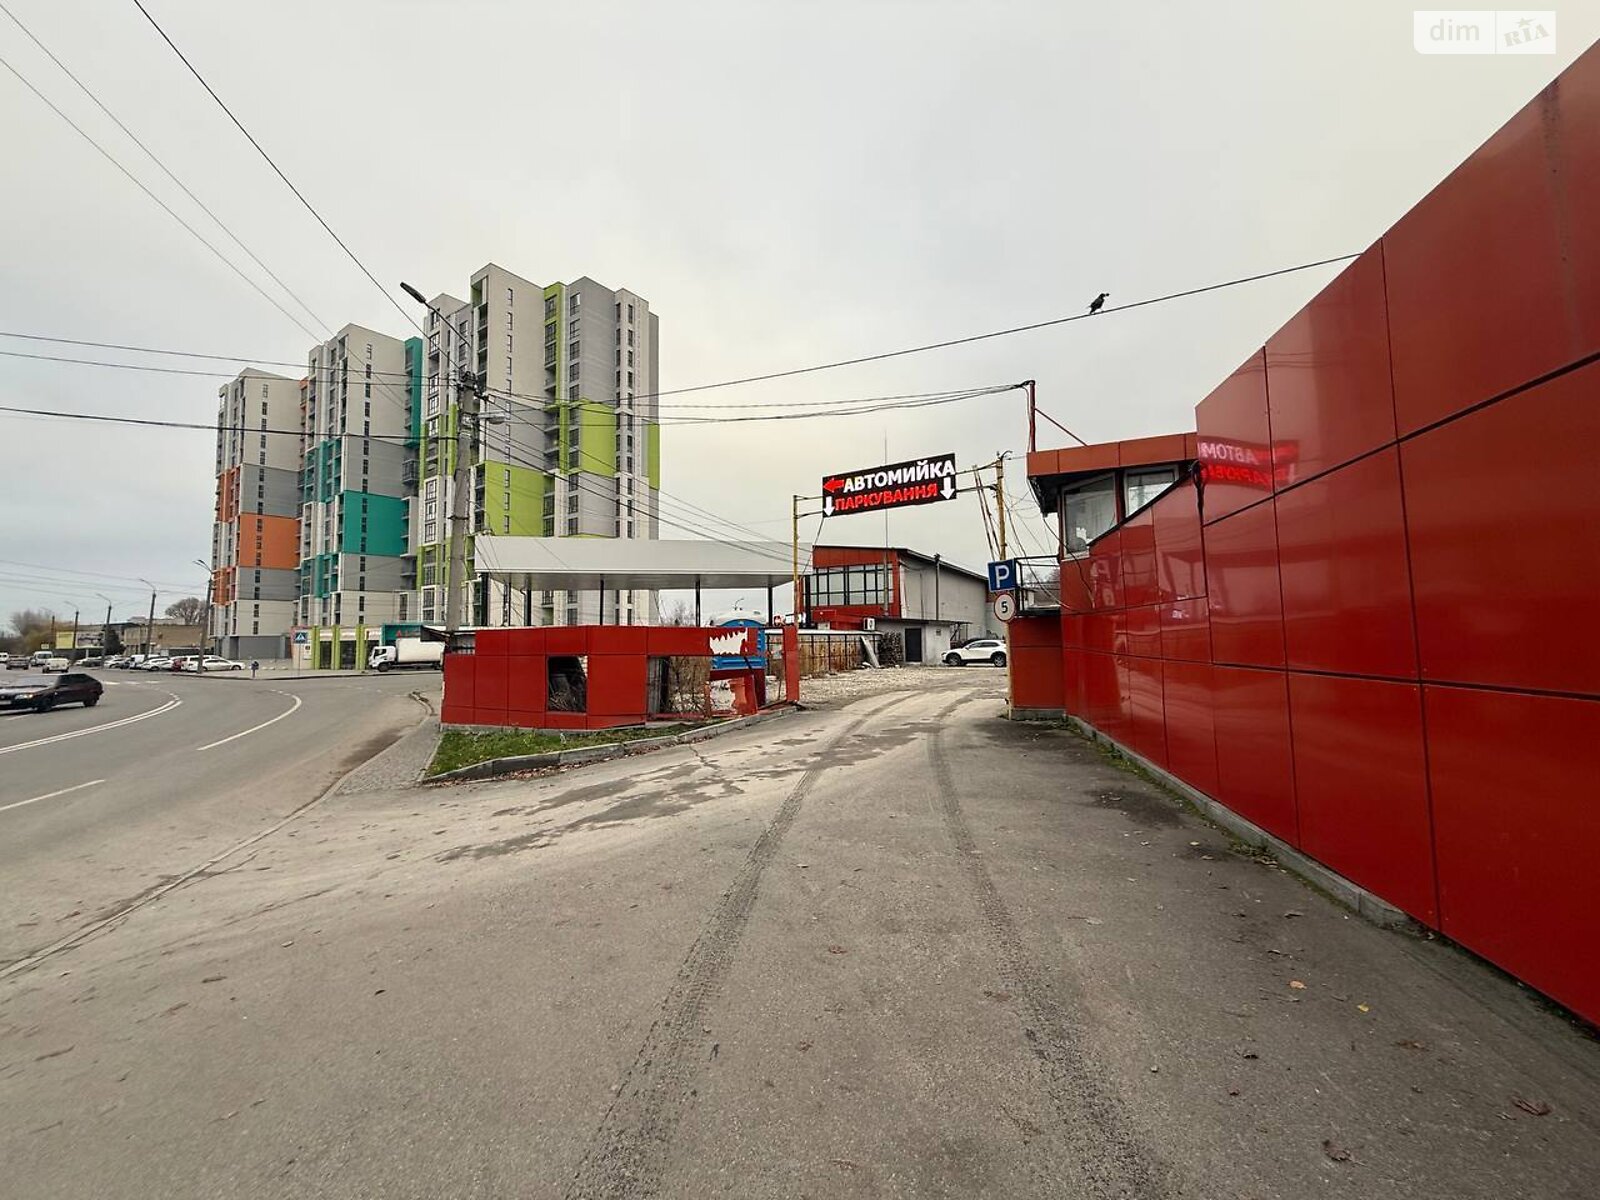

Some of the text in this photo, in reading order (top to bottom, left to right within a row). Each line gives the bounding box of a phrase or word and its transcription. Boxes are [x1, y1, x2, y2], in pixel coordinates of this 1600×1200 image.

[843, 460, 955, 493] АВТОМИЙКА
[835, 483, 938, 511] ПАРКУВАННЯ
[995, 565, 1010, 589] P
[1001, 601, 1008, 614] 5
